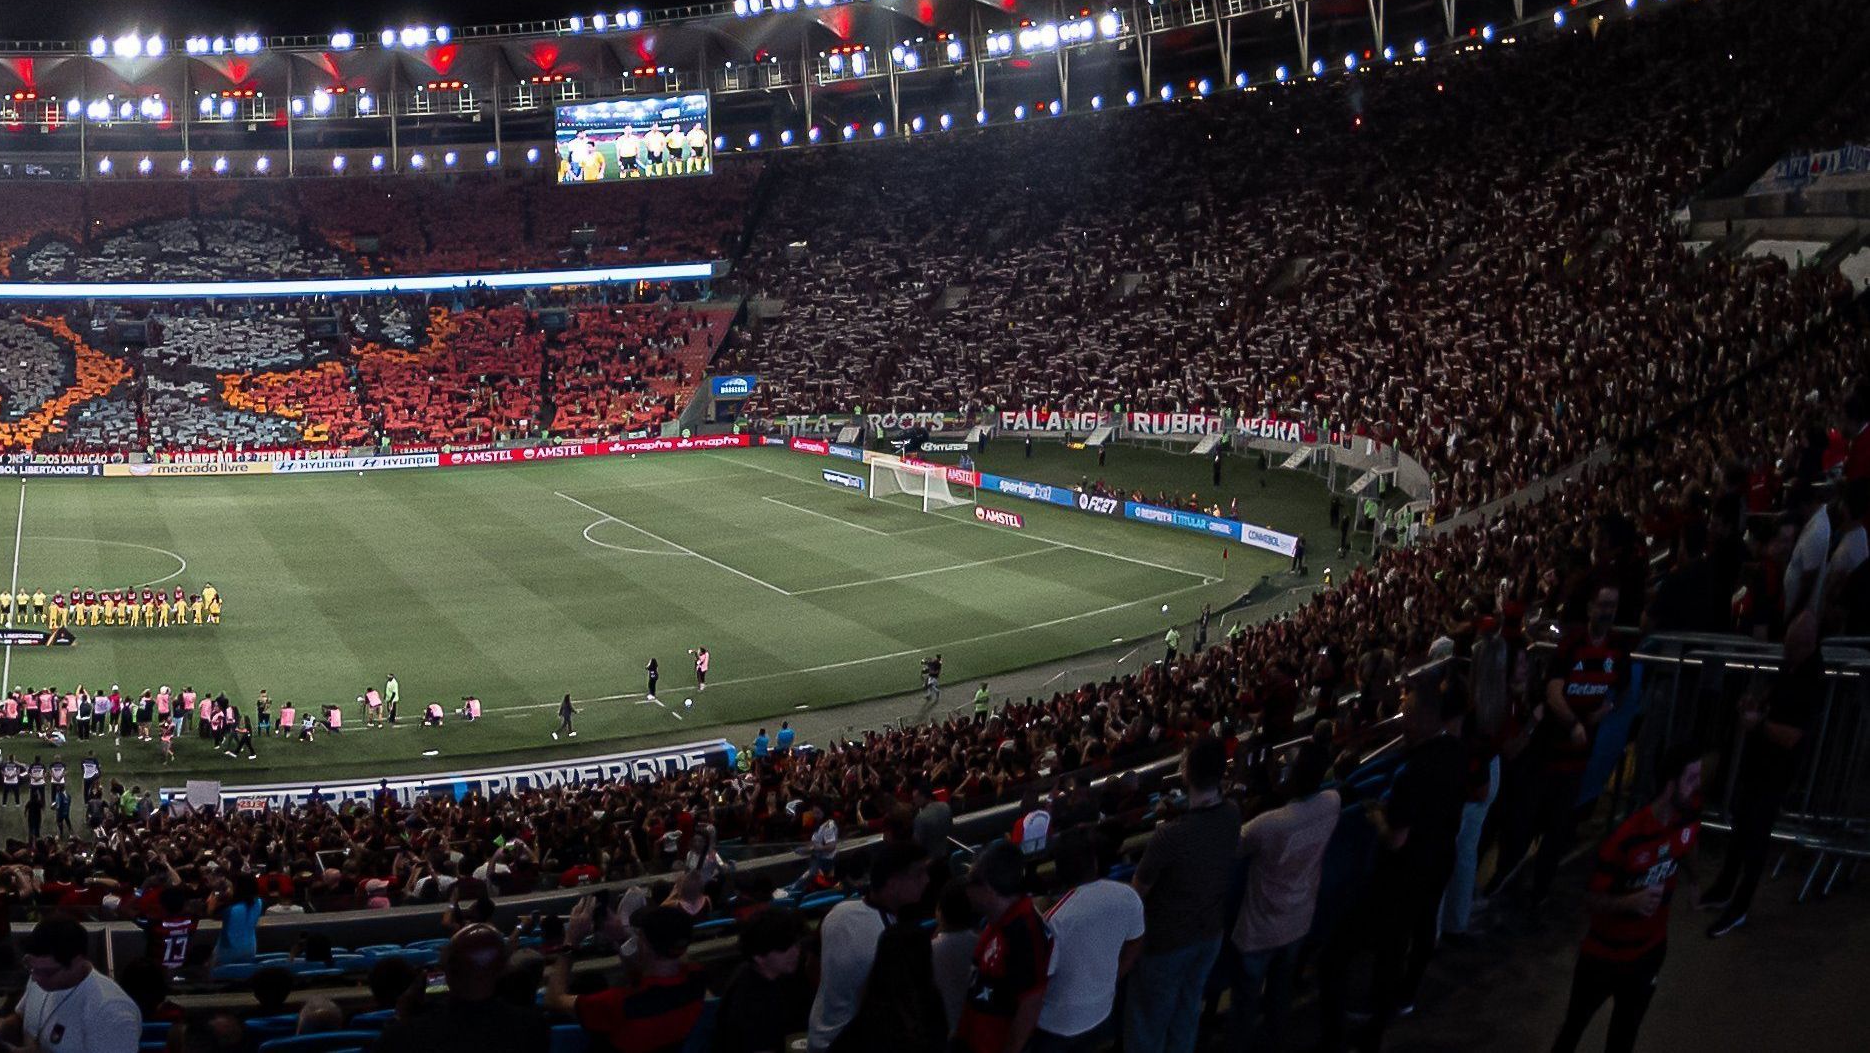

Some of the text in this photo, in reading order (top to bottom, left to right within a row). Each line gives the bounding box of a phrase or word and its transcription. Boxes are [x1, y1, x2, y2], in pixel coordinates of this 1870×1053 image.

[867, 413, 945, 432] ROOTS
[1133, 412, 1222, 436] RUBRO
[1236, 418, 1300, 444] NEGRA
[627, 441, 673, 452] mapfre
[695, 436, 740, 449] mapfre
[464, 450, 514, 464] AMSTEL
[537, 445, 585, 459] AMSTEL
[157, 460, 249, 474] mercado livre
[300, 455, 355, 469] HYUNDAI
[383, 455, 437, 467] HYUNDAI
[20, 465, 88, 475] LIBERTADORES
[948, 469, 975, 485] AMSTEL
[999, 480, 1051, 499] sportingbet
[1087, 496, 1118, 514] FC27
[984, 510, 1021, 526] AMSTEL
[1178, 513, 1207, 530] TITULAR
